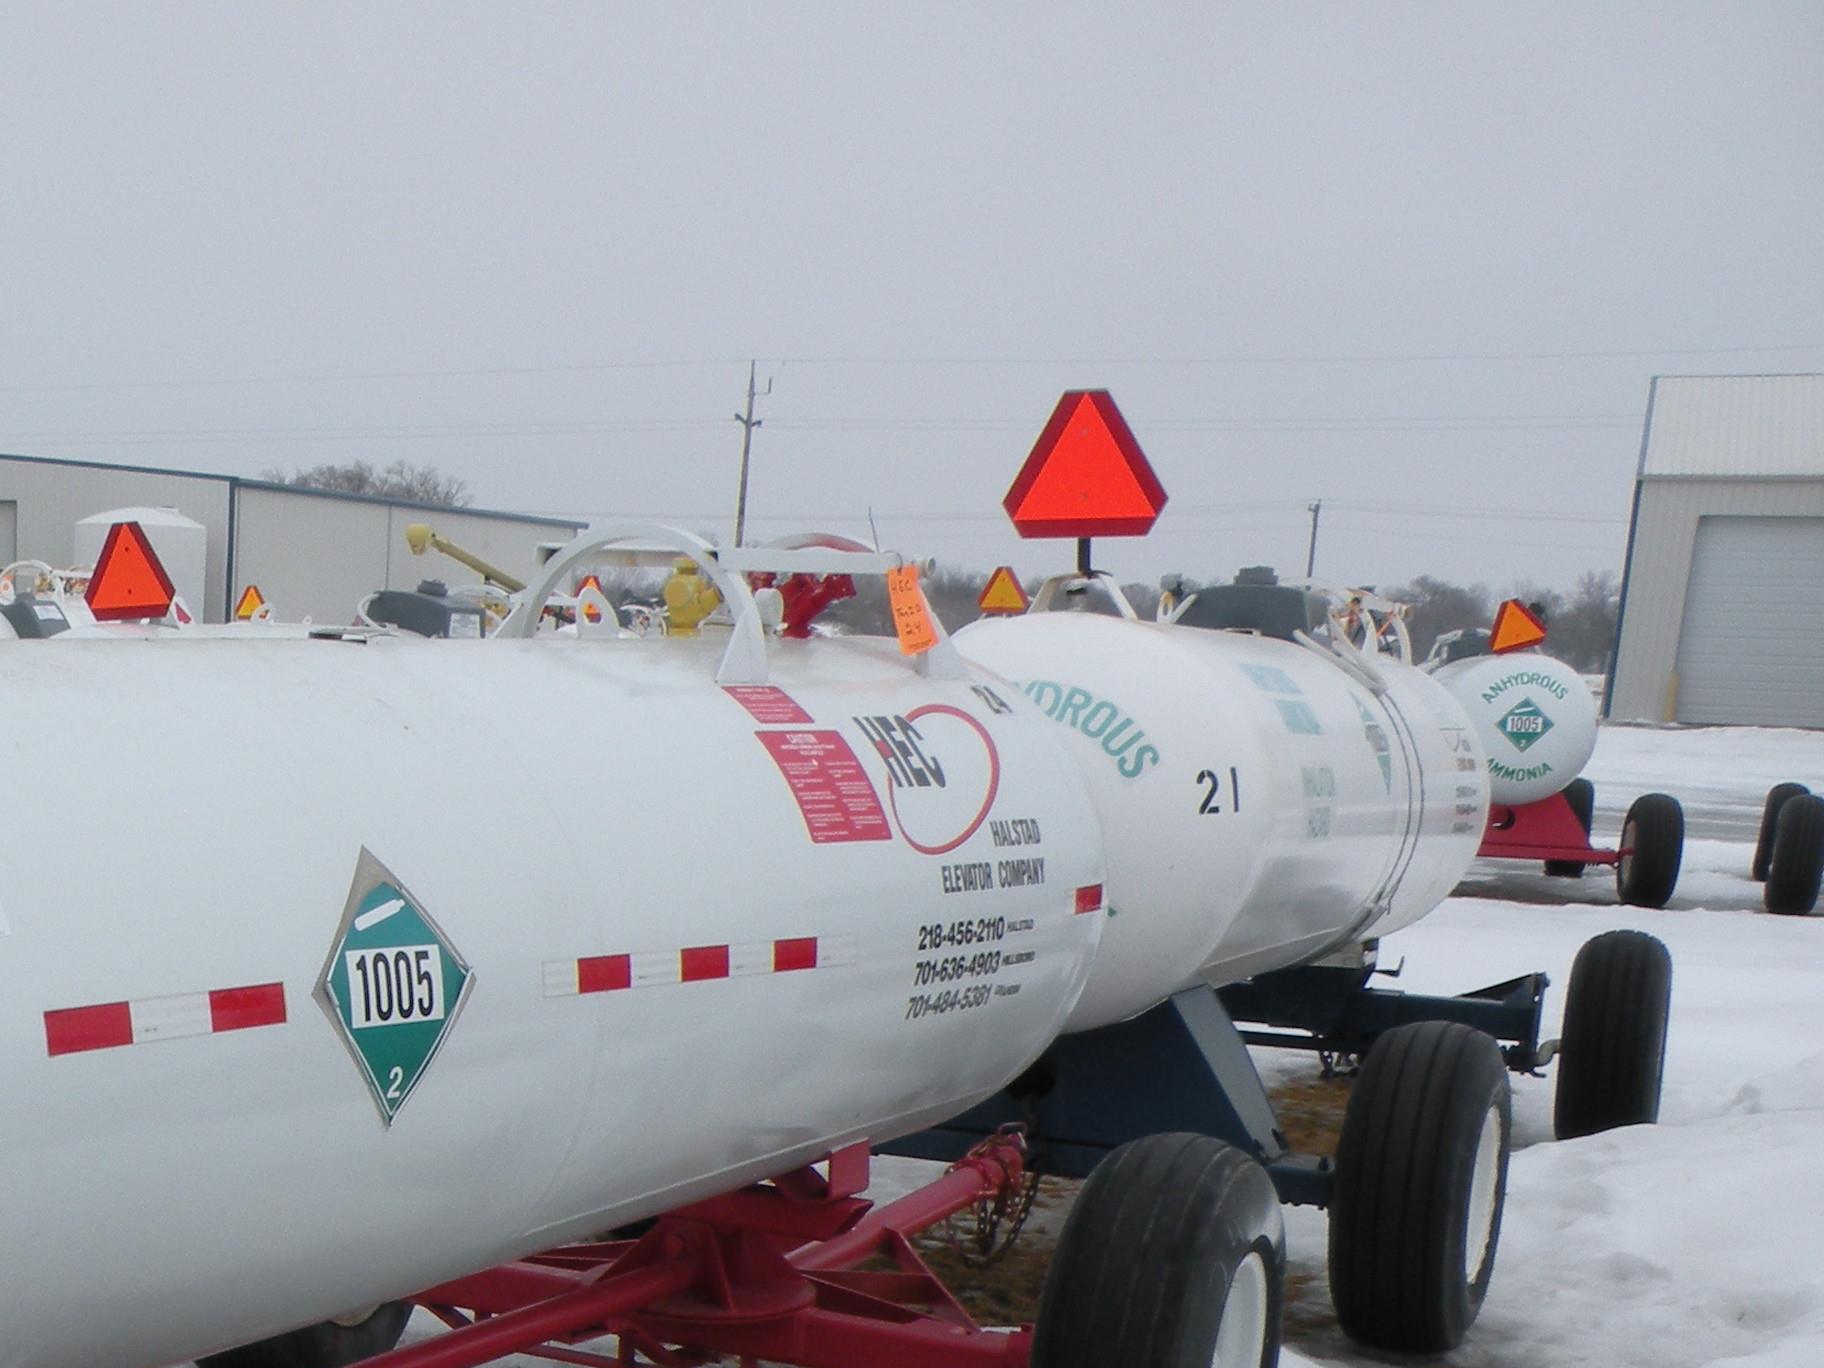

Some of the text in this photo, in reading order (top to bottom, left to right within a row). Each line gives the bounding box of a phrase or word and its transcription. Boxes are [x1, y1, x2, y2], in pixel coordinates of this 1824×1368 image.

[1482, 672, 1568, 704] ANHYDROUS
[1510, 717, 1539, 732] 1005
[852, 714, 946, 788] HEC
[1196, 767, 1240, 815] 21
[990, 819, 1041, 847] HALSTAD
[941, 858, 1045, 894] ELEVATOR COMPANY
[917, 915, 1005, 951] 218-456-2110
[356, 950, 434, 1022] 1005
[913, 951, 1001, 986] 701-636-4903
[387, 1066, 404, 1098] 2
